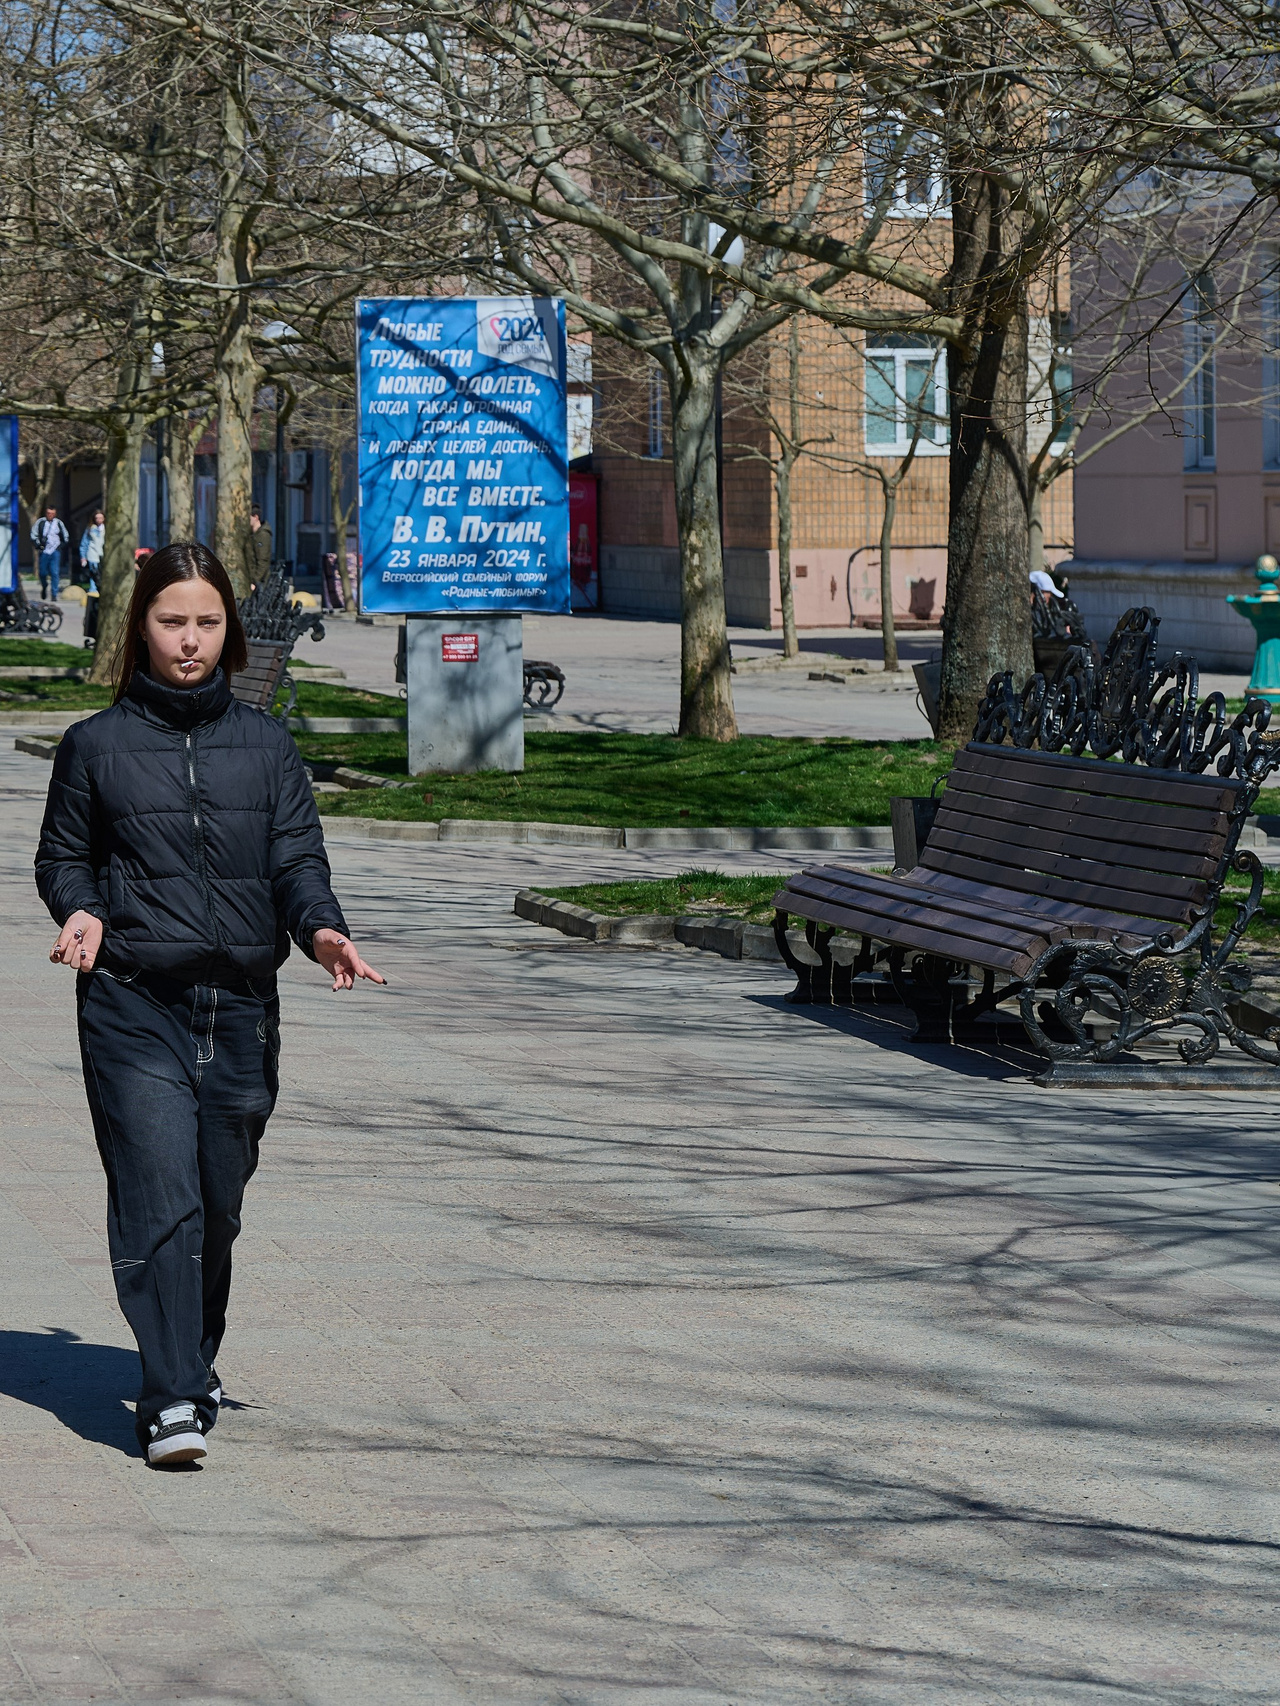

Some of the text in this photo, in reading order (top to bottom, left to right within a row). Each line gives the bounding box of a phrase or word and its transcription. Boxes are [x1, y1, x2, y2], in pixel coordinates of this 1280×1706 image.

[499, 317, 546, 341] 2024
[498, 343, 514, 355] ГОД
[370, 350, 473, 369] ТРУДНОСТИ
[378, 376, 541, 396] МОЖНО ОДОЛЕТЬ,
[368, 400, 532, 415] КОГДА ТАКАЯ ОГРОМНАЯ
[422, 420, 524, 435] СТРАНА ЕДИНА,
[368, 438, 552, 455] И ЛЮБЫХ ЦЕЛЕЙ ДОСТИЧЬ,
[390, 460, 503, 483] КОГДА МЫ
[422, 486, 546, 507] ВСЕ ВМЕСТЕ.
[391, 515, 419, 544] В.
[425, 515, 452, 544] В.
[387, 549, 411, 568] 23
[417, 553, 477, 568] ЯНВАРЯ
[483, 549, 531, 568] 2024
[462, 571, 512, 583] СЕМЕЙНЫЙ
[515, 572, 548, 583] ФОРУМ
